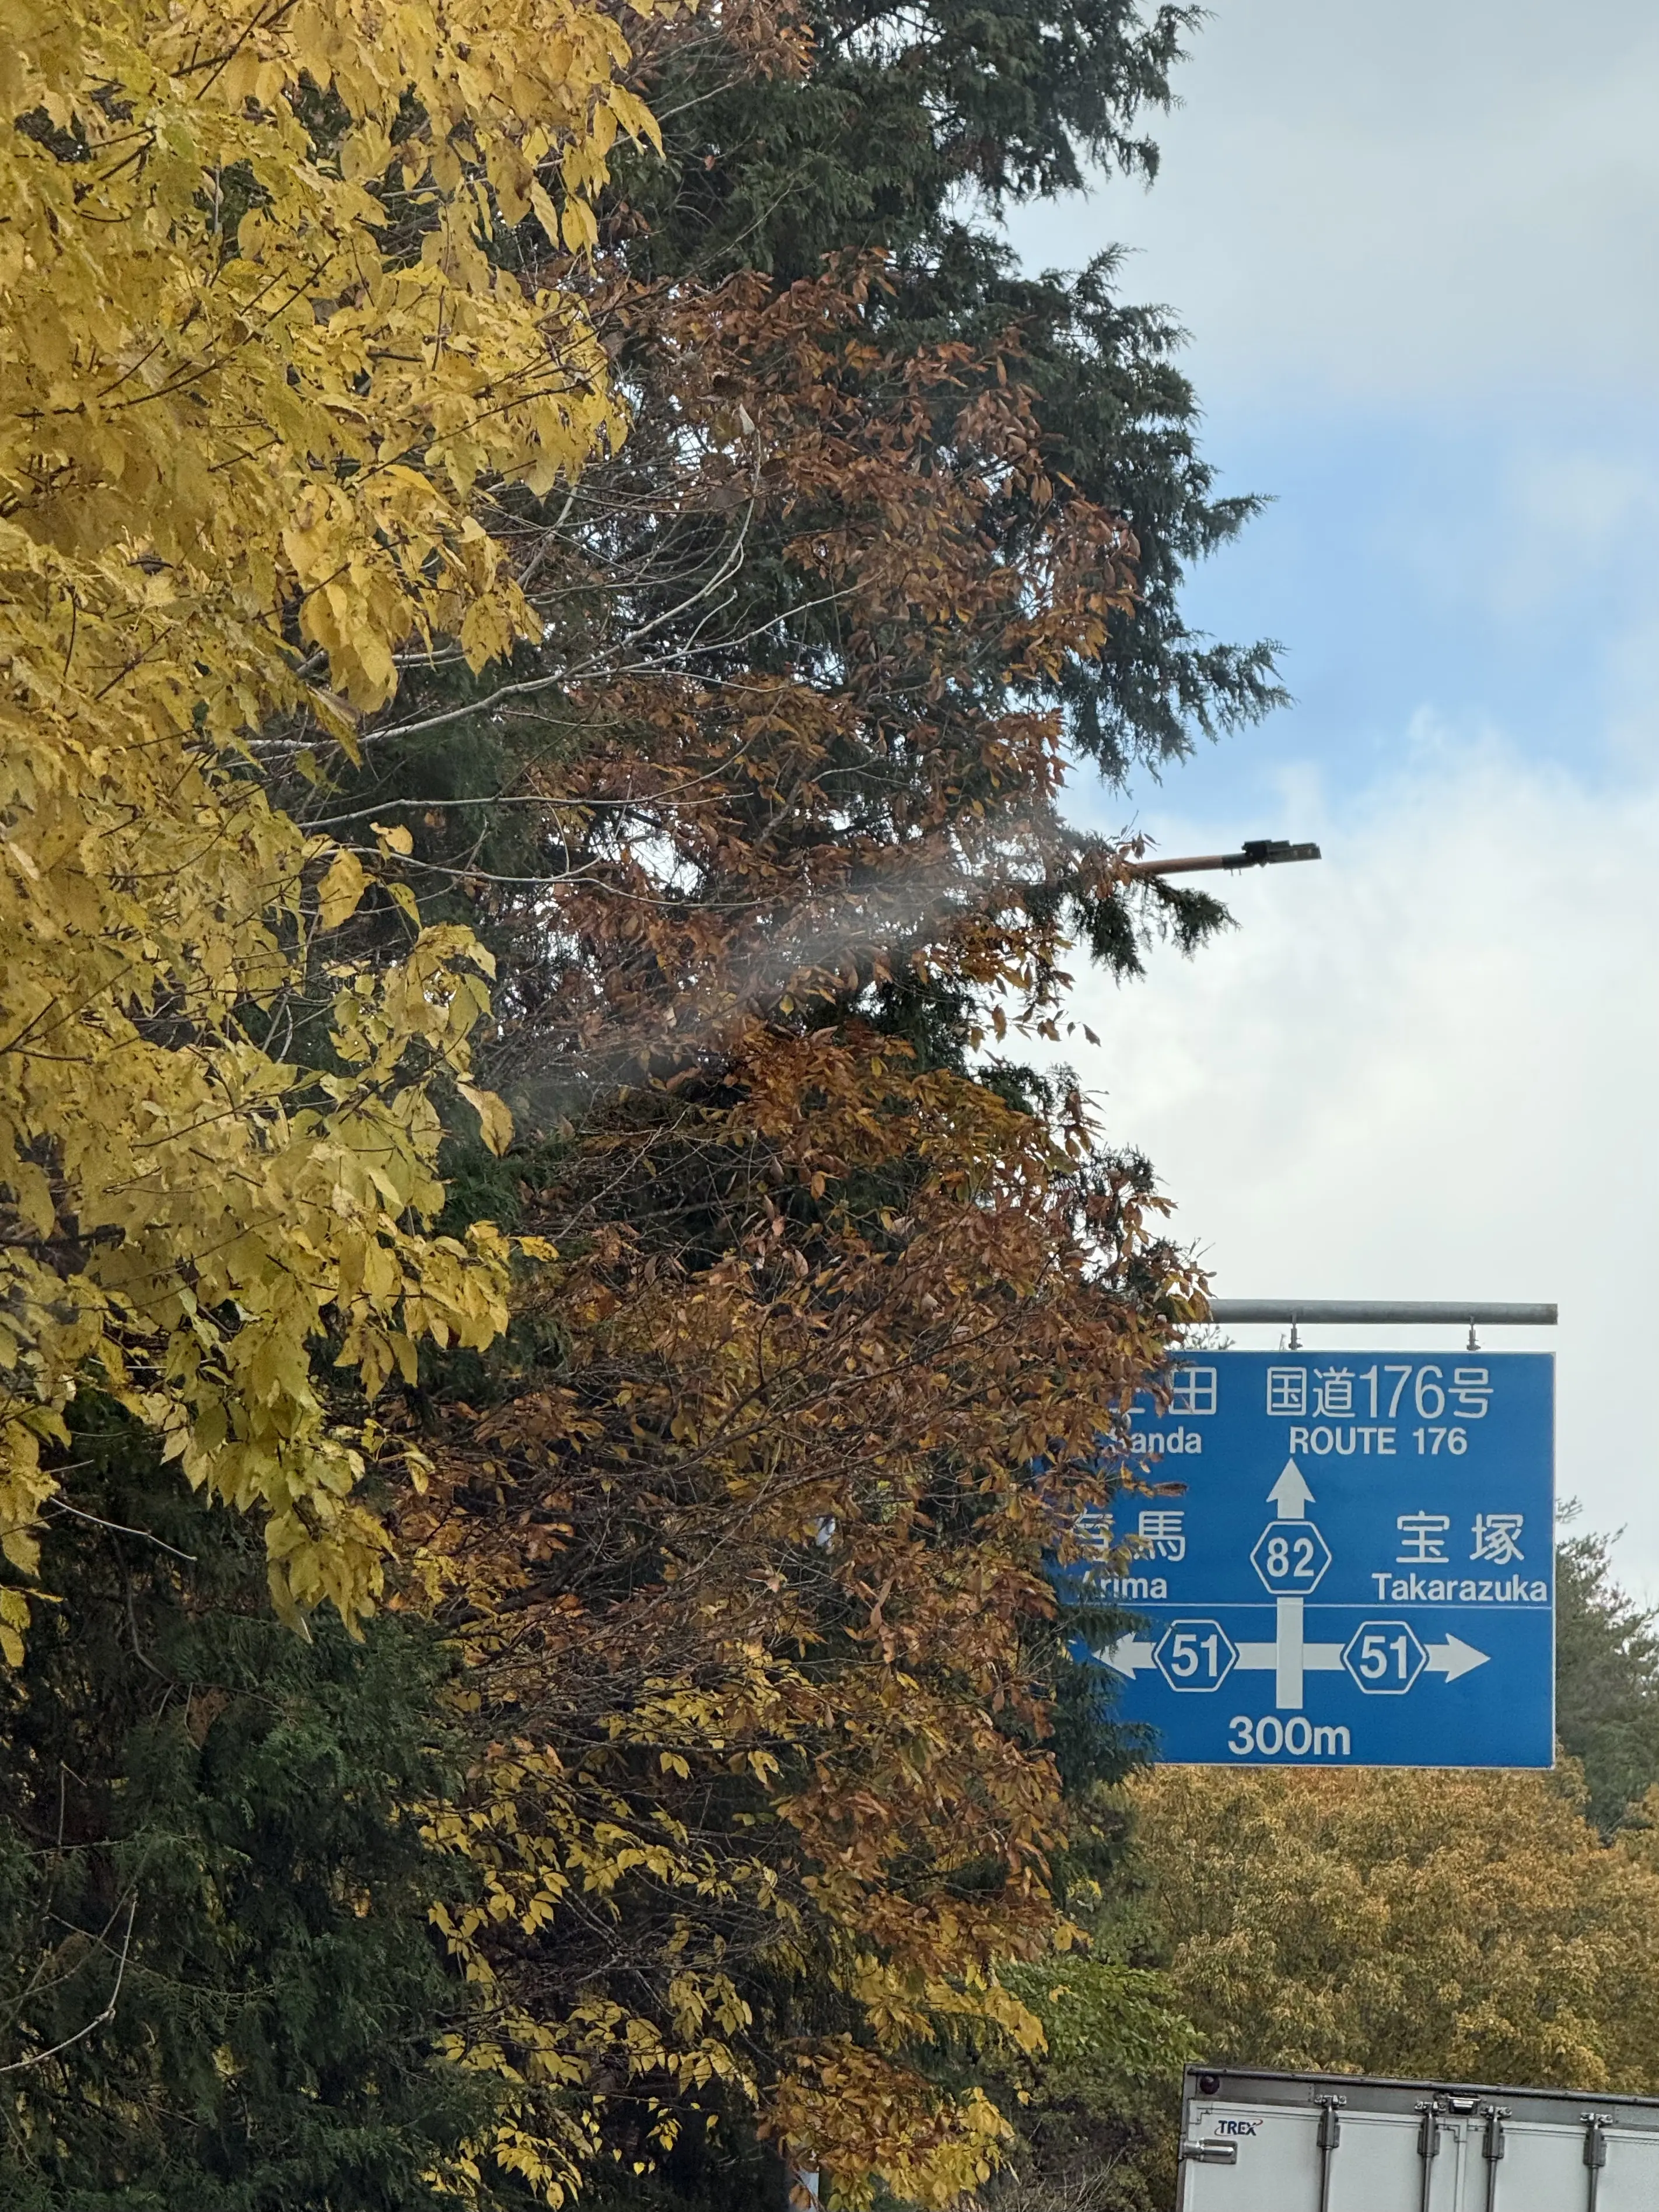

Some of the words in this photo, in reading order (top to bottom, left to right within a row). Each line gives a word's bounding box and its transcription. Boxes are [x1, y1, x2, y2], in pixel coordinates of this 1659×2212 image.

[1266, 1365, 1494, 1419] 国道176号
[1289, 1426, 1396, 1455] ROUTE
[1412, 1427, 1468, 1455] 176
[1266, 1537, 1315, 1577] 82
[1395, 1510, 1525, 1565] 宝塚
[1371, 1573, 1548, 1602] Takarazuka
[1171, 1634, 1218, 1677] 51
[1359, 1635, 1408, 1679] 51
[1228, 1716, 1350, 1755] 300m
[1217, 2120, 1257, 2136] TREX
